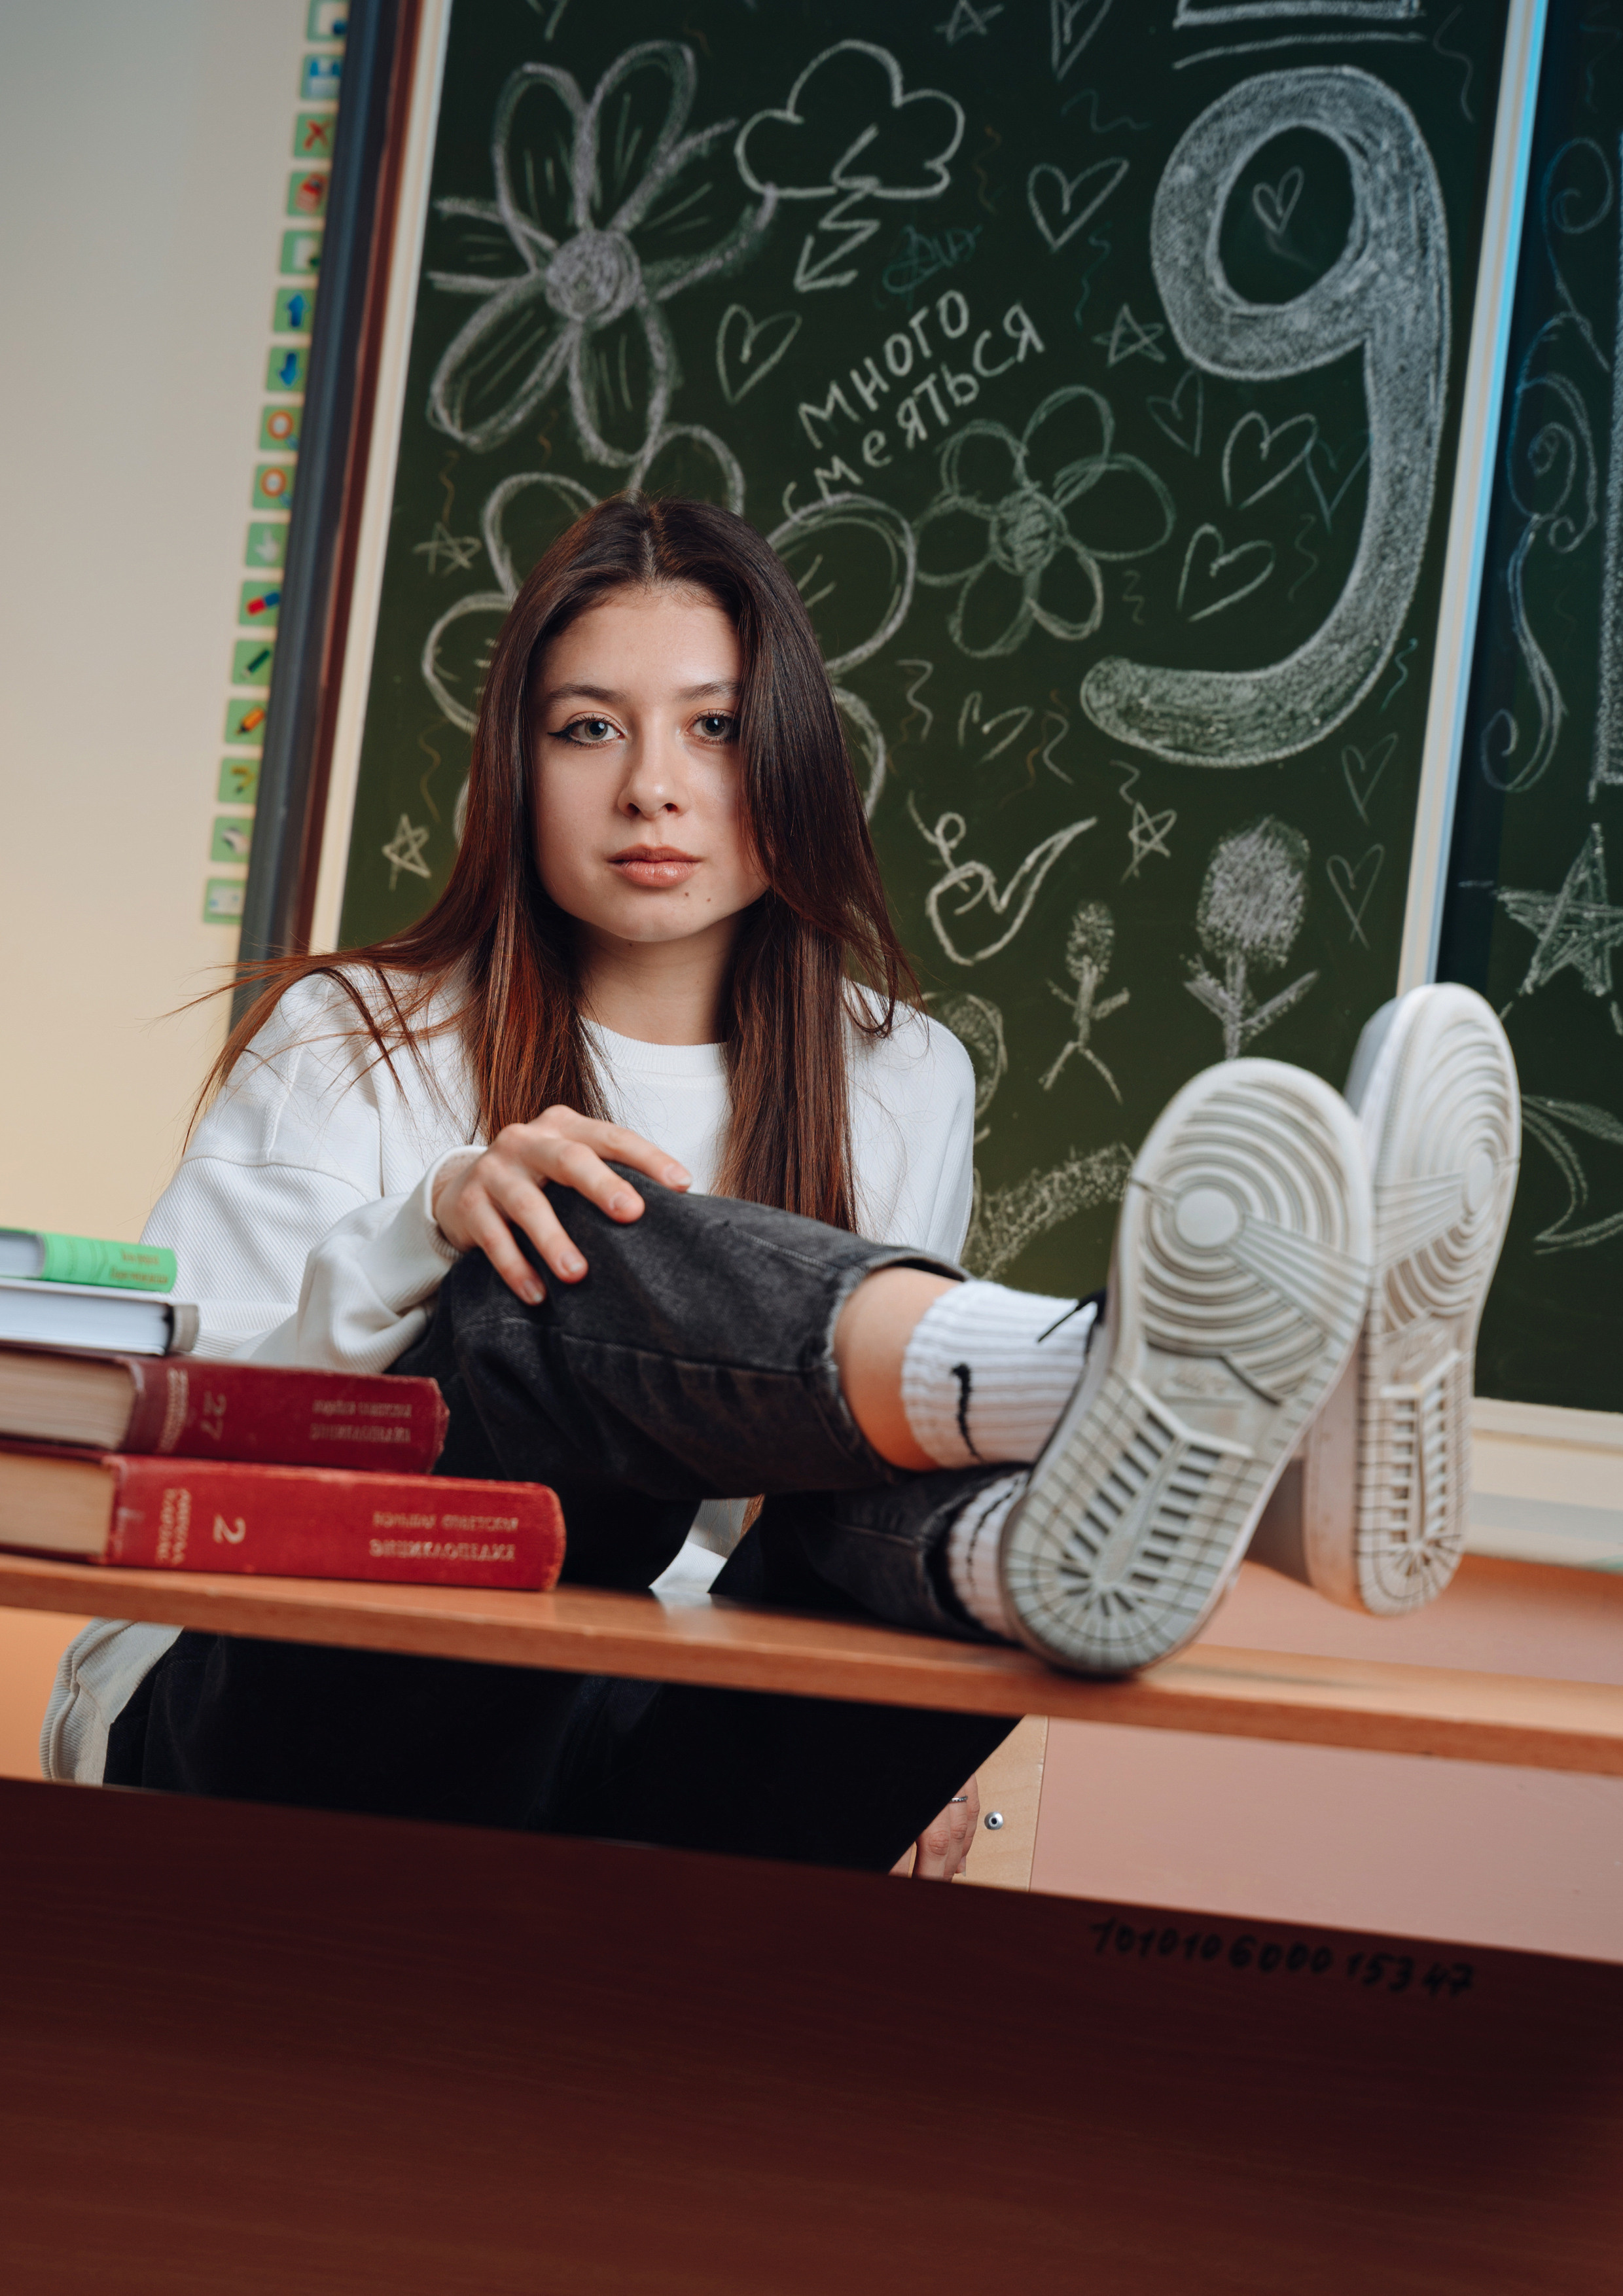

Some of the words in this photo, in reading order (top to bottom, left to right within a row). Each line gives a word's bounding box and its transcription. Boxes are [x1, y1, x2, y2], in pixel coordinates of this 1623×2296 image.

[1080, 64, 1452, 768] 9
[200, 1390, 227, 1442] 27
[213, 1513, 246, 1545] 2
